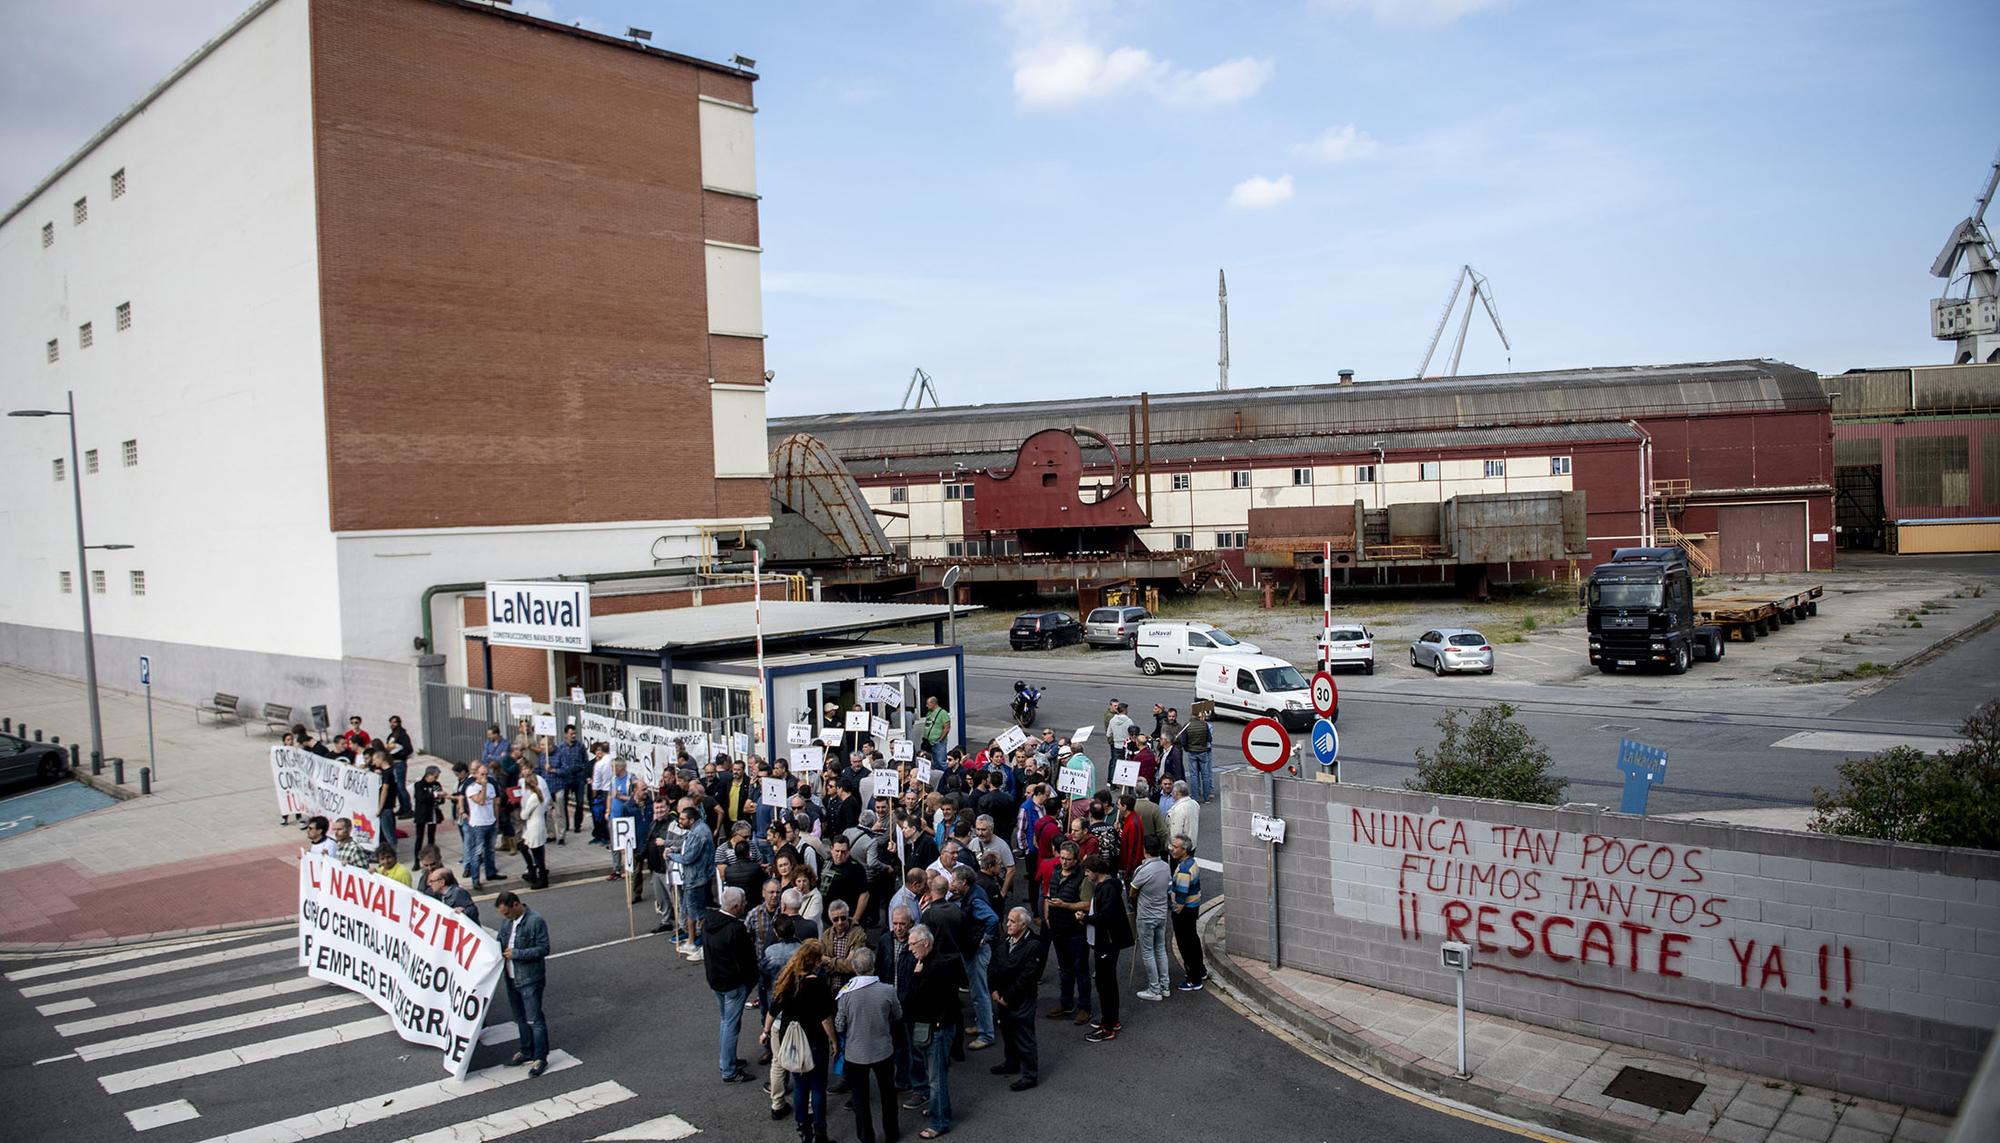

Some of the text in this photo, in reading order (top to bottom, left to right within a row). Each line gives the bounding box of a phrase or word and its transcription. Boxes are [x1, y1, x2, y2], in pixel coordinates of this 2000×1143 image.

[492, 591, 581, 627] LaNaval
[493, 631, 532, 640] CONSTRUCCIONES
[533, 634, 554, 642] NAVALES
[1317, 687, 1329, 701] 30
[1070, 770, 1086, 778] NAVAL
[1352, 808, 1702, 883] NUNCA TAN POCOS
[1399, 854, 1727, 927] FUIMOS TANTOS
[330, 866, 400, 923] NAVAL
[409, 896, 430, 940] EZ
[430, 913, 482, 971] ITXI
[316, 945, 376, 990] EMPLEO
[1441, 901, 1692, 977] RESCATE
[1728, 938, 1787, 989] YA
